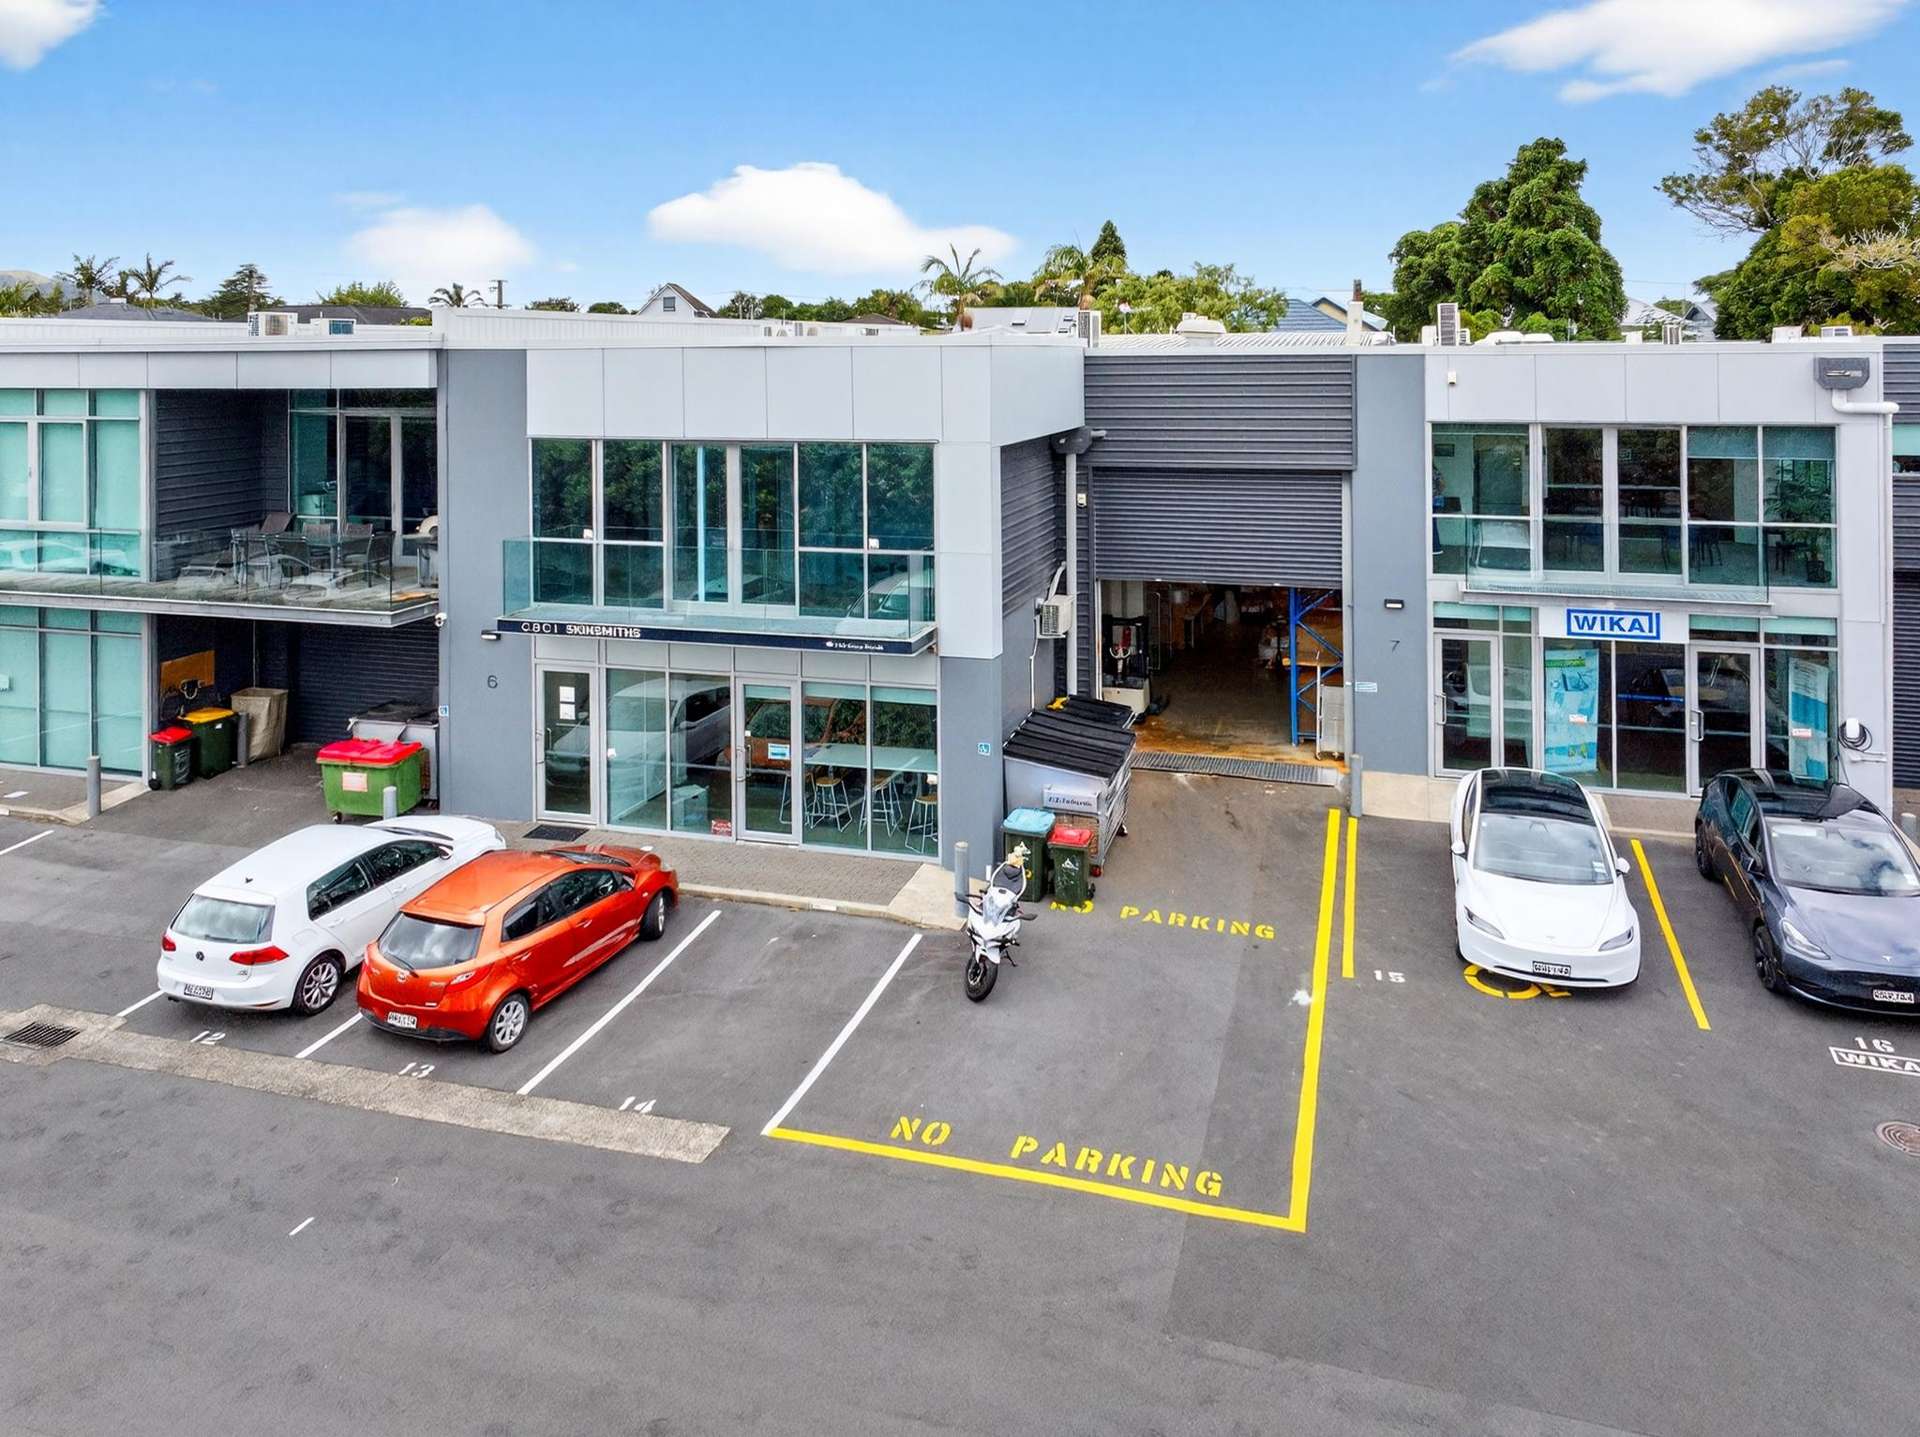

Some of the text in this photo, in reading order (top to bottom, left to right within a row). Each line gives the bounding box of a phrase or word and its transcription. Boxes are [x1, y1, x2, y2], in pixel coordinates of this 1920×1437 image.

[1573, 614, 1646, 633] WIKA
[1389, 639, 1401, 654] 7
[487, 674, 498, 689] 6
[1120, 905, 1275, 940] PARKING
[1373, 969, 1406, 983] 15
[190, 1030, 226, 1046] 12
[1854, 1036, 1895, 1053] 16
[398, 1062, 436, 1078] 13
[1838, 1051, 1920, 1073] WIKA
[618, 1096, 657, 1114] 14
[890, 1115, 1224, 1199] NO PARKING
